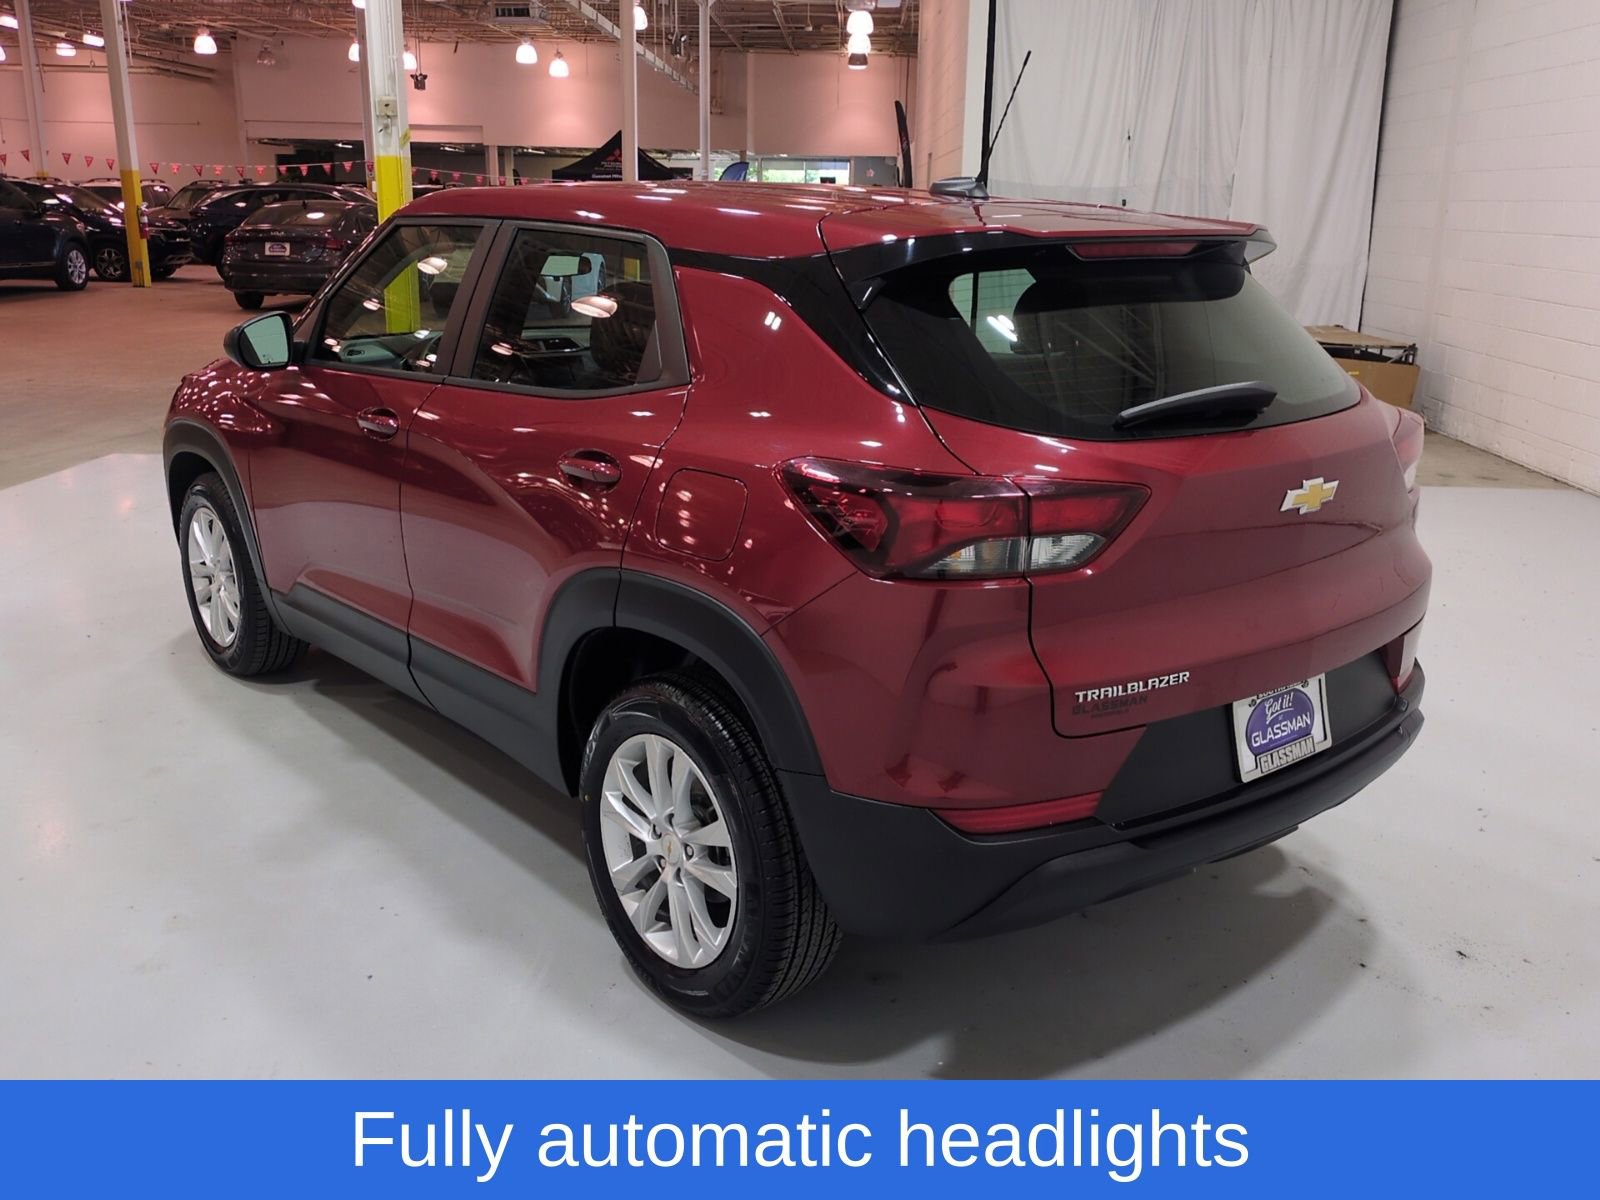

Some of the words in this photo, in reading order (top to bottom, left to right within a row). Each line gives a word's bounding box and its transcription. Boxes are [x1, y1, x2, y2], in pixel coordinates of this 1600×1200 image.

[1075, 671, 1190, 703] TRAILBLAZER
[1072, 695, 1148, 715] GLASSMAN
[1265, 697, 1281, 717] Got
[1281, 692, 1294, 709] it!
[1251, 712, 1311, 747] GLASSMAN
[1260, 737, 1315, 773] GLASSMAN
